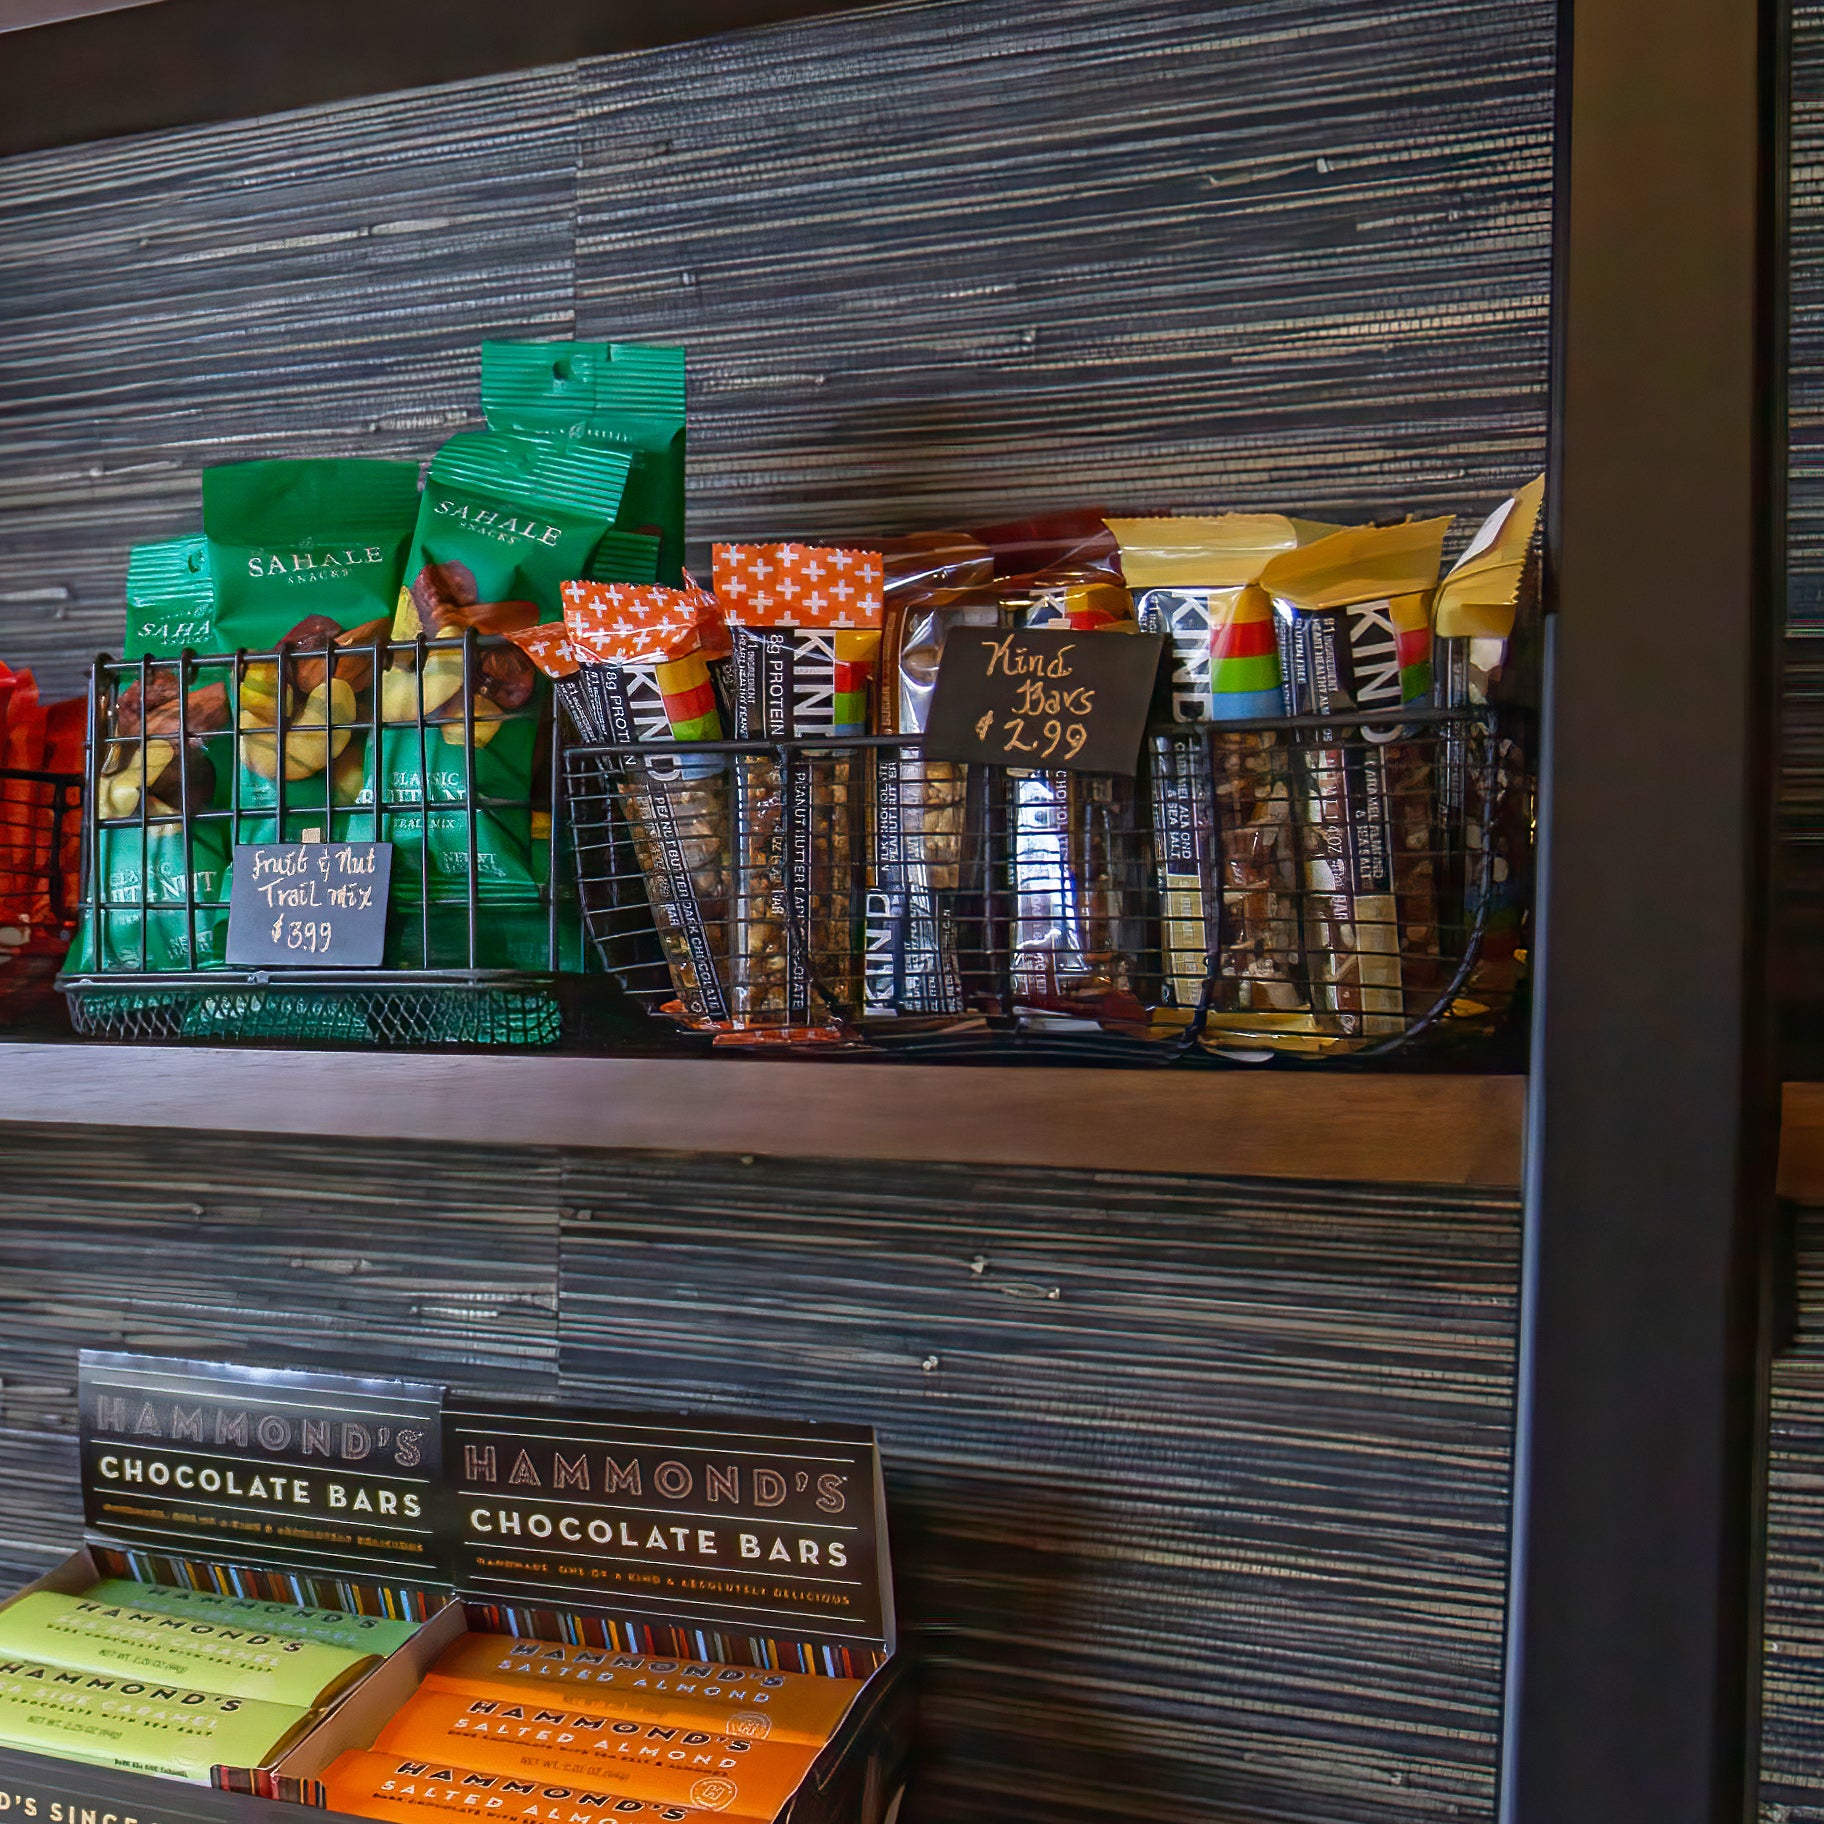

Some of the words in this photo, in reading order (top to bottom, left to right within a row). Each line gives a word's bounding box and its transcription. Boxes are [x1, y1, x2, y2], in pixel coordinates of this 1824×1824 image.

[434, 498, 562, 548] SAHALE
[459, 521, 518, 546] SNACKS
[247, 545, 384, 578] SAHALE
[287, 567, 350, 585] SNACKS
[137, 619, 211, 640] SAHA
[766, 634, 784, 654] 8g
[982, 633, 1076, 678] Kind
[1172, 591, 1214, 722] KIND
[1347, 599, 1404, 743] KIND
[622, 664, 683, 781] KIND
[769, 661, 785, 735] PROTEIN
[1011, 679, 1096, 716] Bars
[864, 893, 898, 1016] KIND
[97, 1394, 424, 1467] HAMMOND'S
[99, 1455, 311, 1504] CHOCOLATE
[329, 1484, 422, 1518] BARS
[463, 1444, 848, 1514] HAMMOND'S
[470, 1508, 719, 1555] CHOCOLATE
[740, 1532, 849, 1568] BARS
[76, 1601, 305, 1653] HAMMOND'S
[498, 1659, 614, 1683] SALTED
[634, 1679, 771, 1704] ALMOND
[510, 1643, 784, 1688] HAMMOND'S
[453, 1717, 575, 1744] SALTED
[594, 1739, 737, 1769] ALMOND
[468, 1699, 753, 1753] HAMMOND'S
[379, 1780, 504, 1810] SALTED
[394, 1760, 689, 1822] HAMMOND'S
